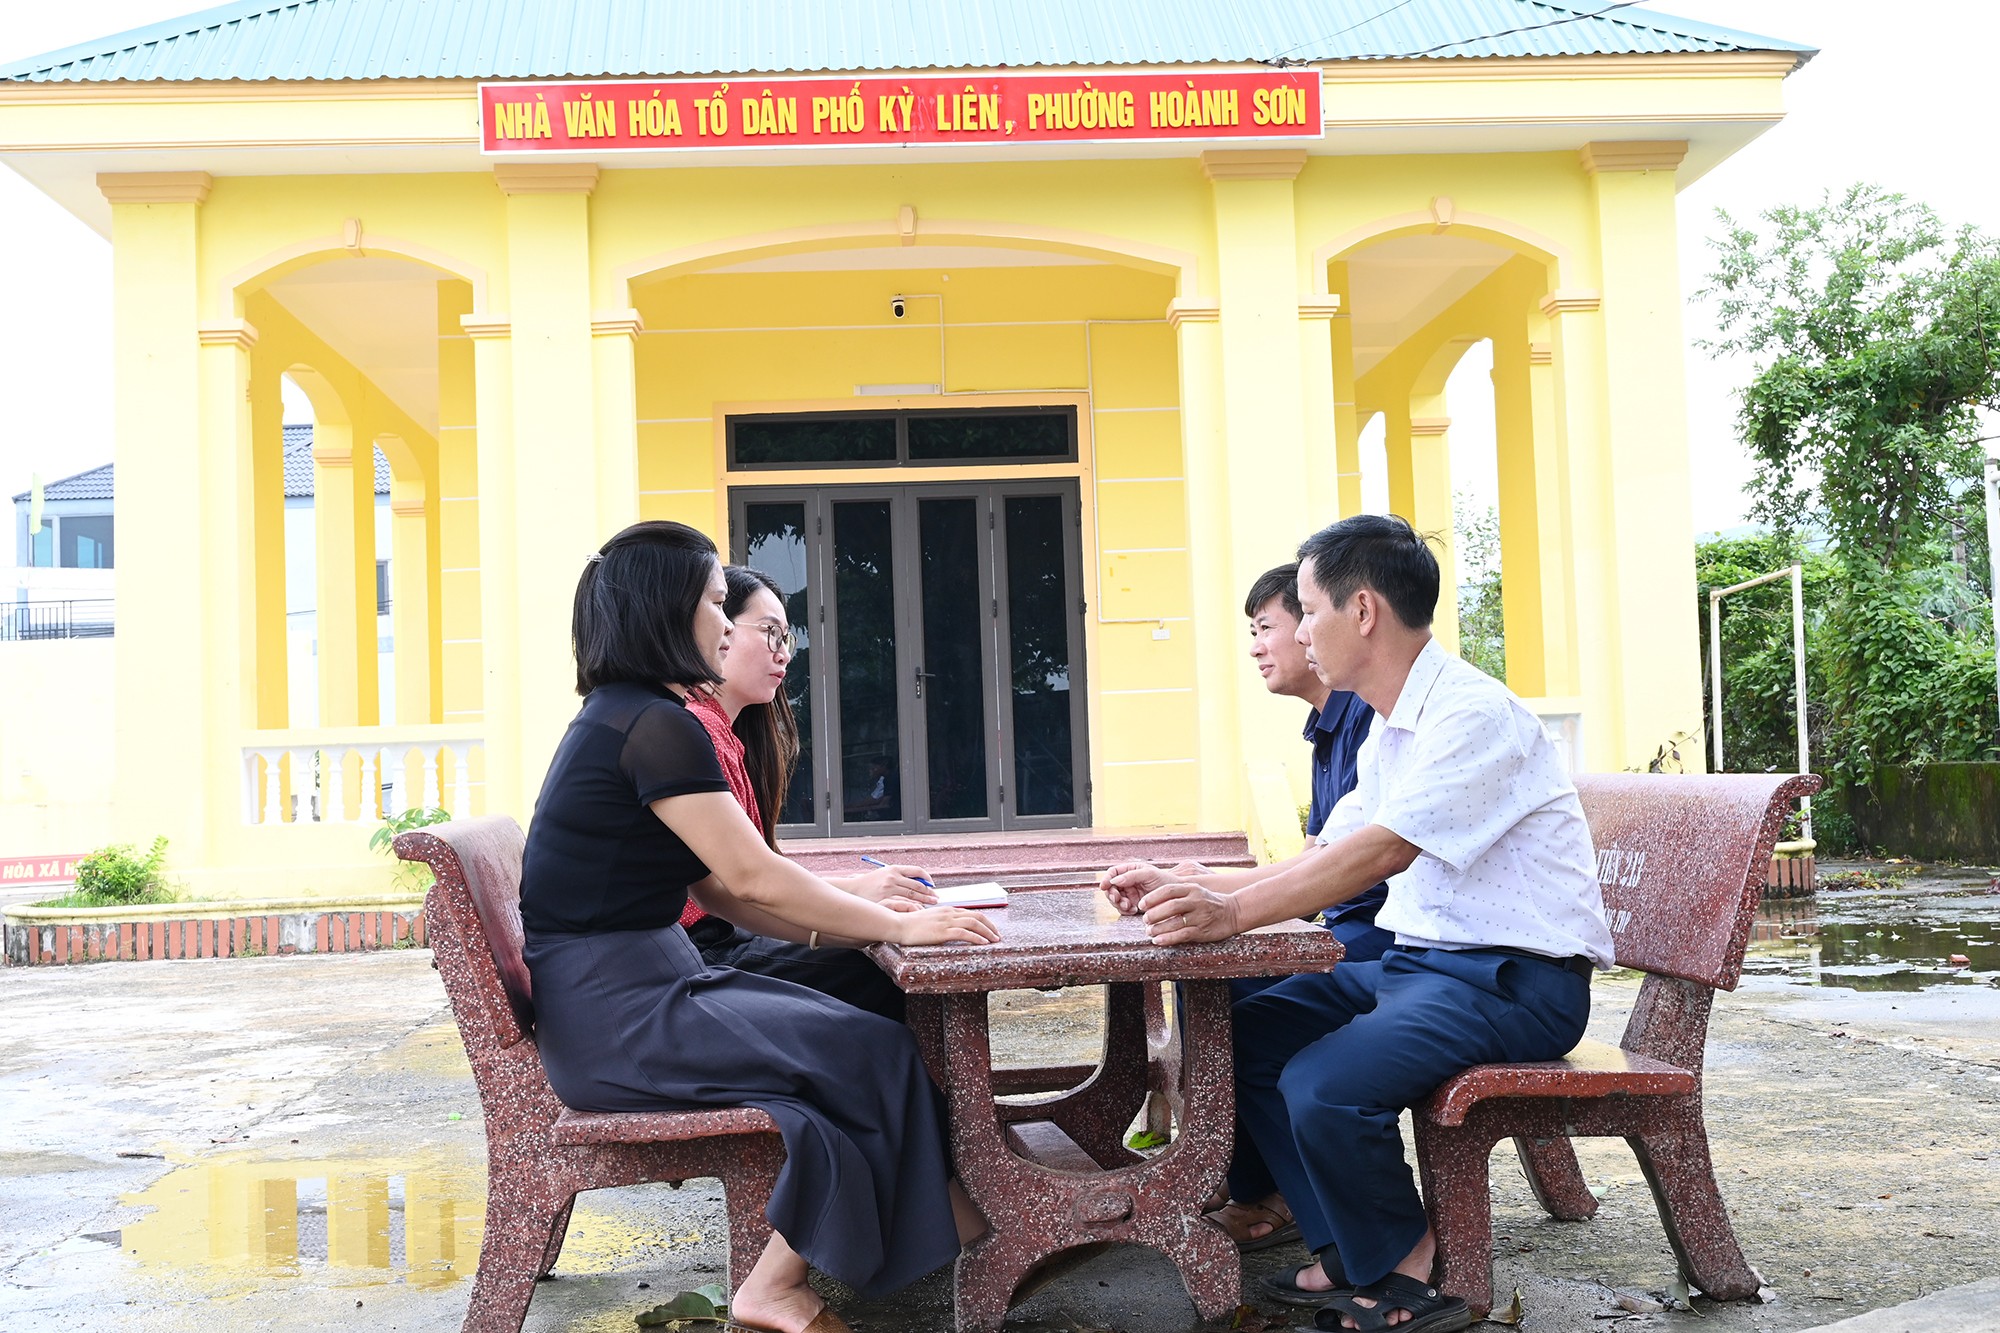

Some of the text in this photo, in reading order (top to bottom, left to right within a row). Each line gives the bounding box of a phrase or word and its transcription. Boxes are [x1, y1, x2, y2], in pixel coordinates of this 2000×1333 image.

[494, 93, 553, 139] NHÀ
[562, 92, 617, 137] VĂN
[628, 89, 683, 136] HÓA
[694, 83, 730, 136] TỔ
[741, 88, 799, 134] DÂN
[812, 81, 865, 133] PHỐ
[879, 85, 915, 132] KỲ
[1027, 80, 1135, 130] PHƯỜNG
[1149, 80, 1239, 128] HOÀNH
[1253, 84, 1307, 125] SƠN
[2, 861, 35, 880] HÒA
[38, 860, 60, 878] XÃ
[1619, 849, 1646, 887] 213
